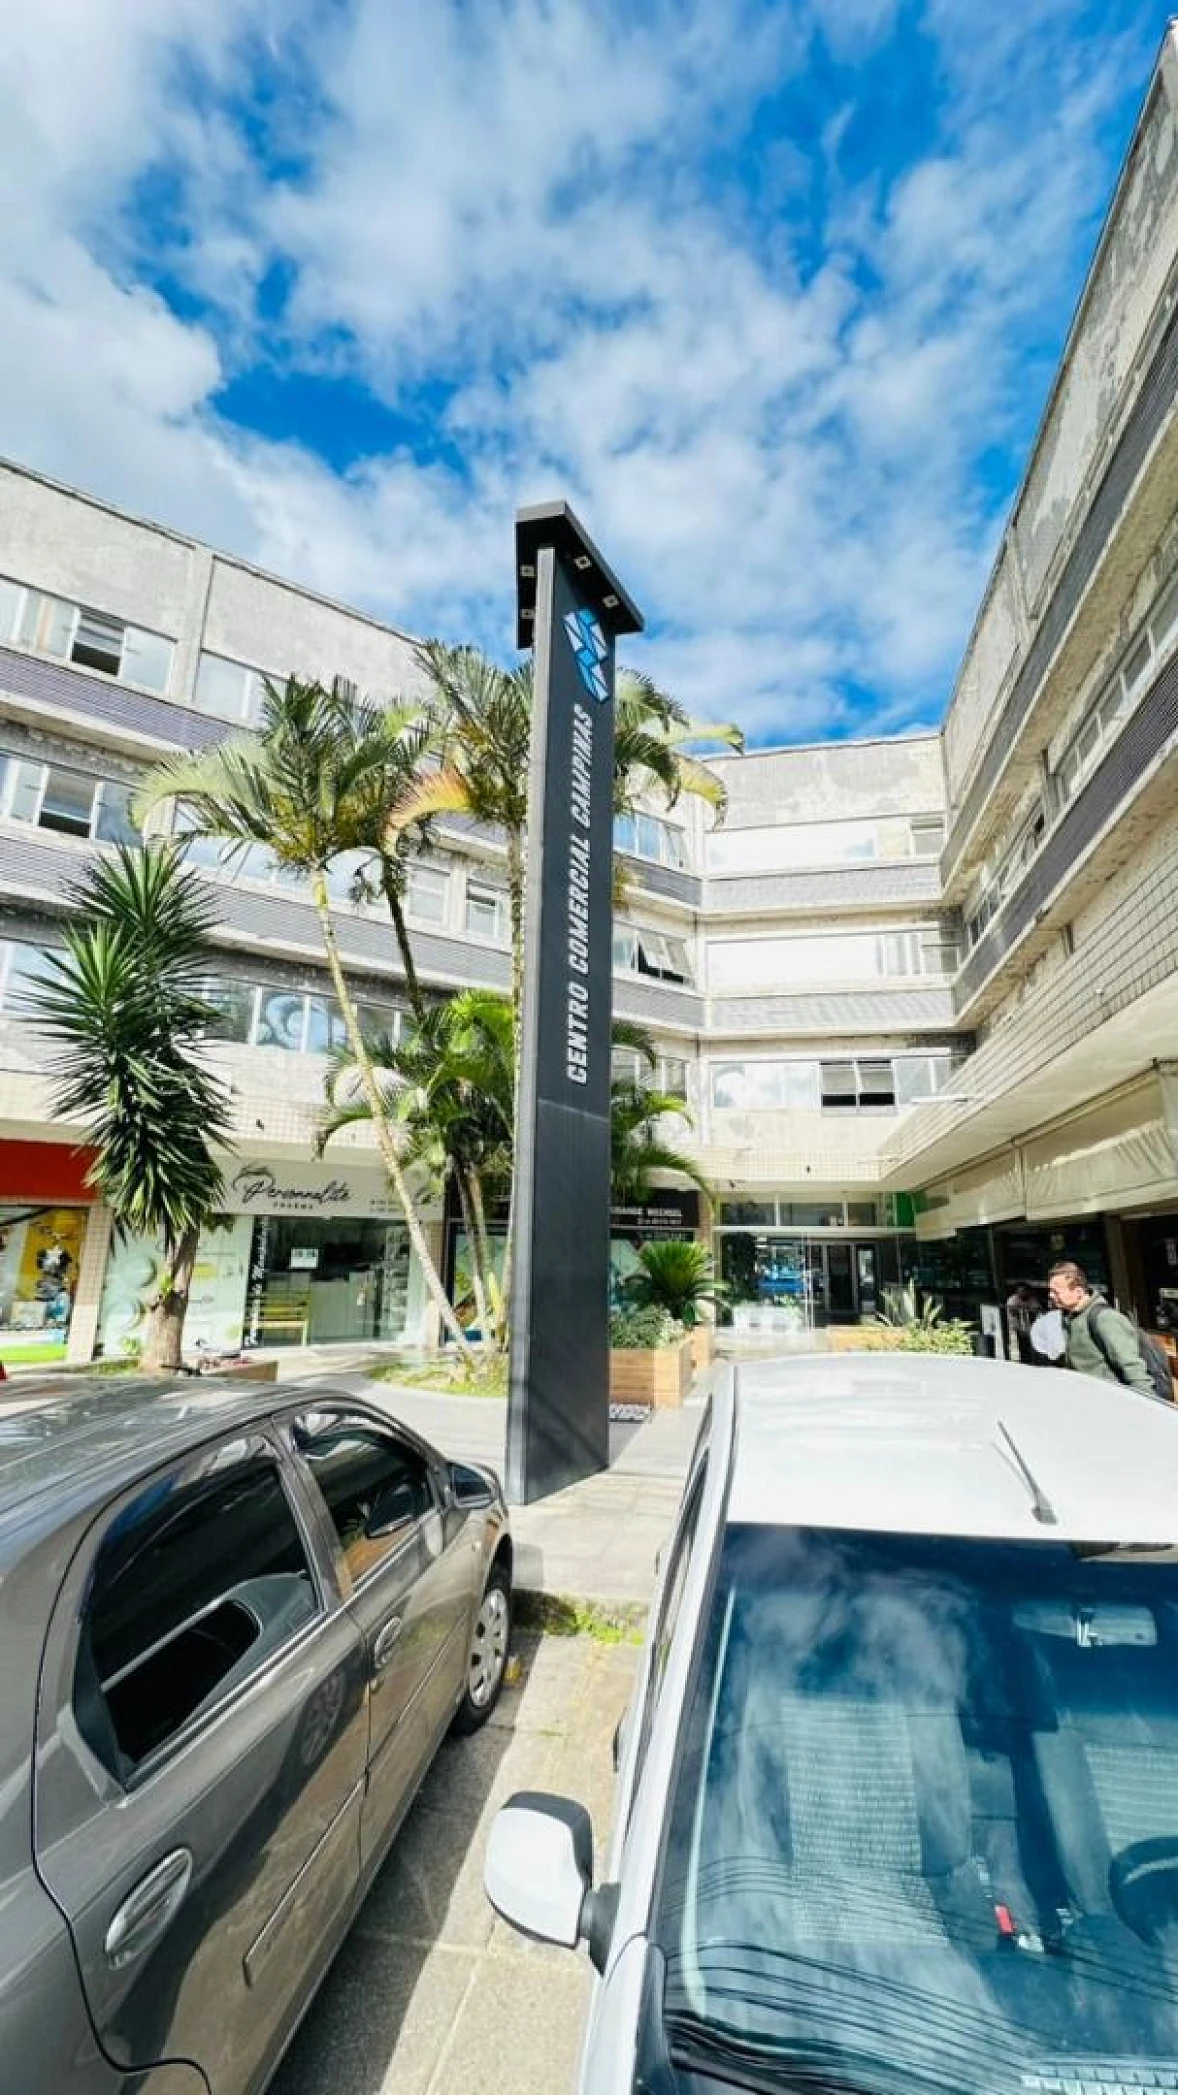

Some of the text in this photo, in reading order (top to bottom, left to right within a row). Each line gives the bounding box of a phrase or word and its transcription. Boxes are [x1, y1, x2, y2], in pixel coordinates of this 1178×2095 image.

[567, 703, 595, 1085] CENTRO COMERCIAL CAMPINAS
